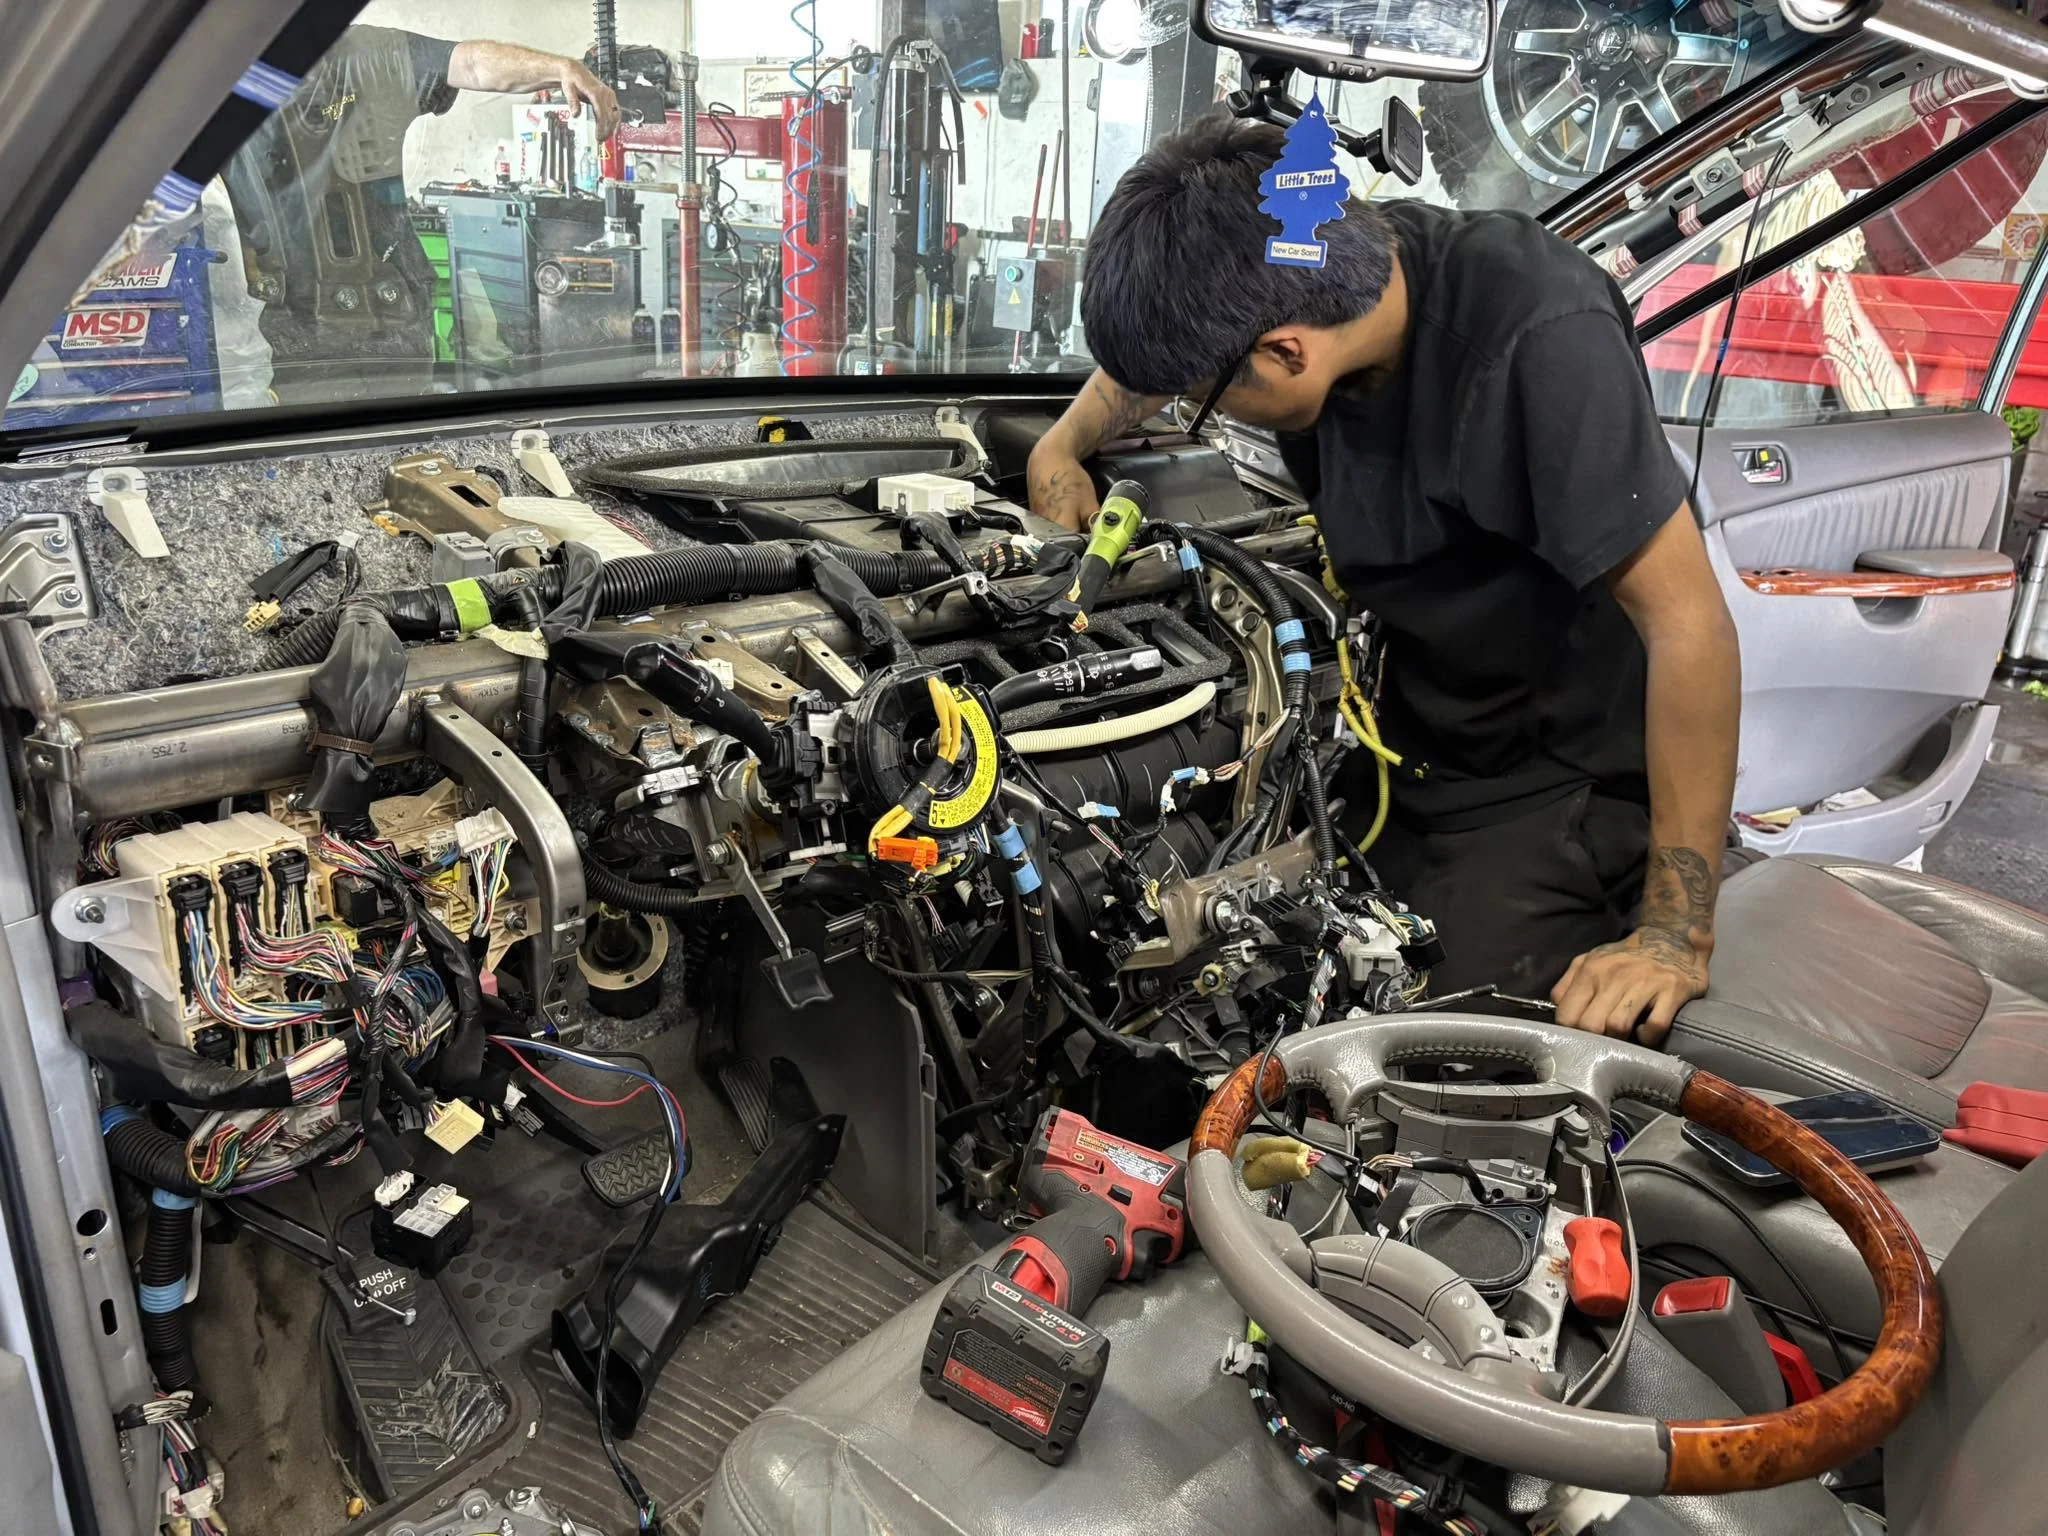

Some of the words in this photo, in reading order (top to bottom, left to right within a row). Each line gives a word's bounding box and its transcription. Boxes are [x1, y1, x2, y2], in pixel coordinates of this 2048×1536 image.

[1279, 174, 1304, 187] Little
[1307, 172, 1333, 185] Trees
[1273, 245, 1287, 253] New
[1288, 247, 1299, 255] Car
[1301, 249, 1320, 257] Scent
[67, 312, 146, 337] MSD
[151, 741, 188, 759] 2.755
[931, 803, 938, 825] 5
[359, 1268, 393, 1288] PUSH
[383, 1277, 407, 1295] OFF
[1022, 1299, 1087, 1337] REDLITHIUM
